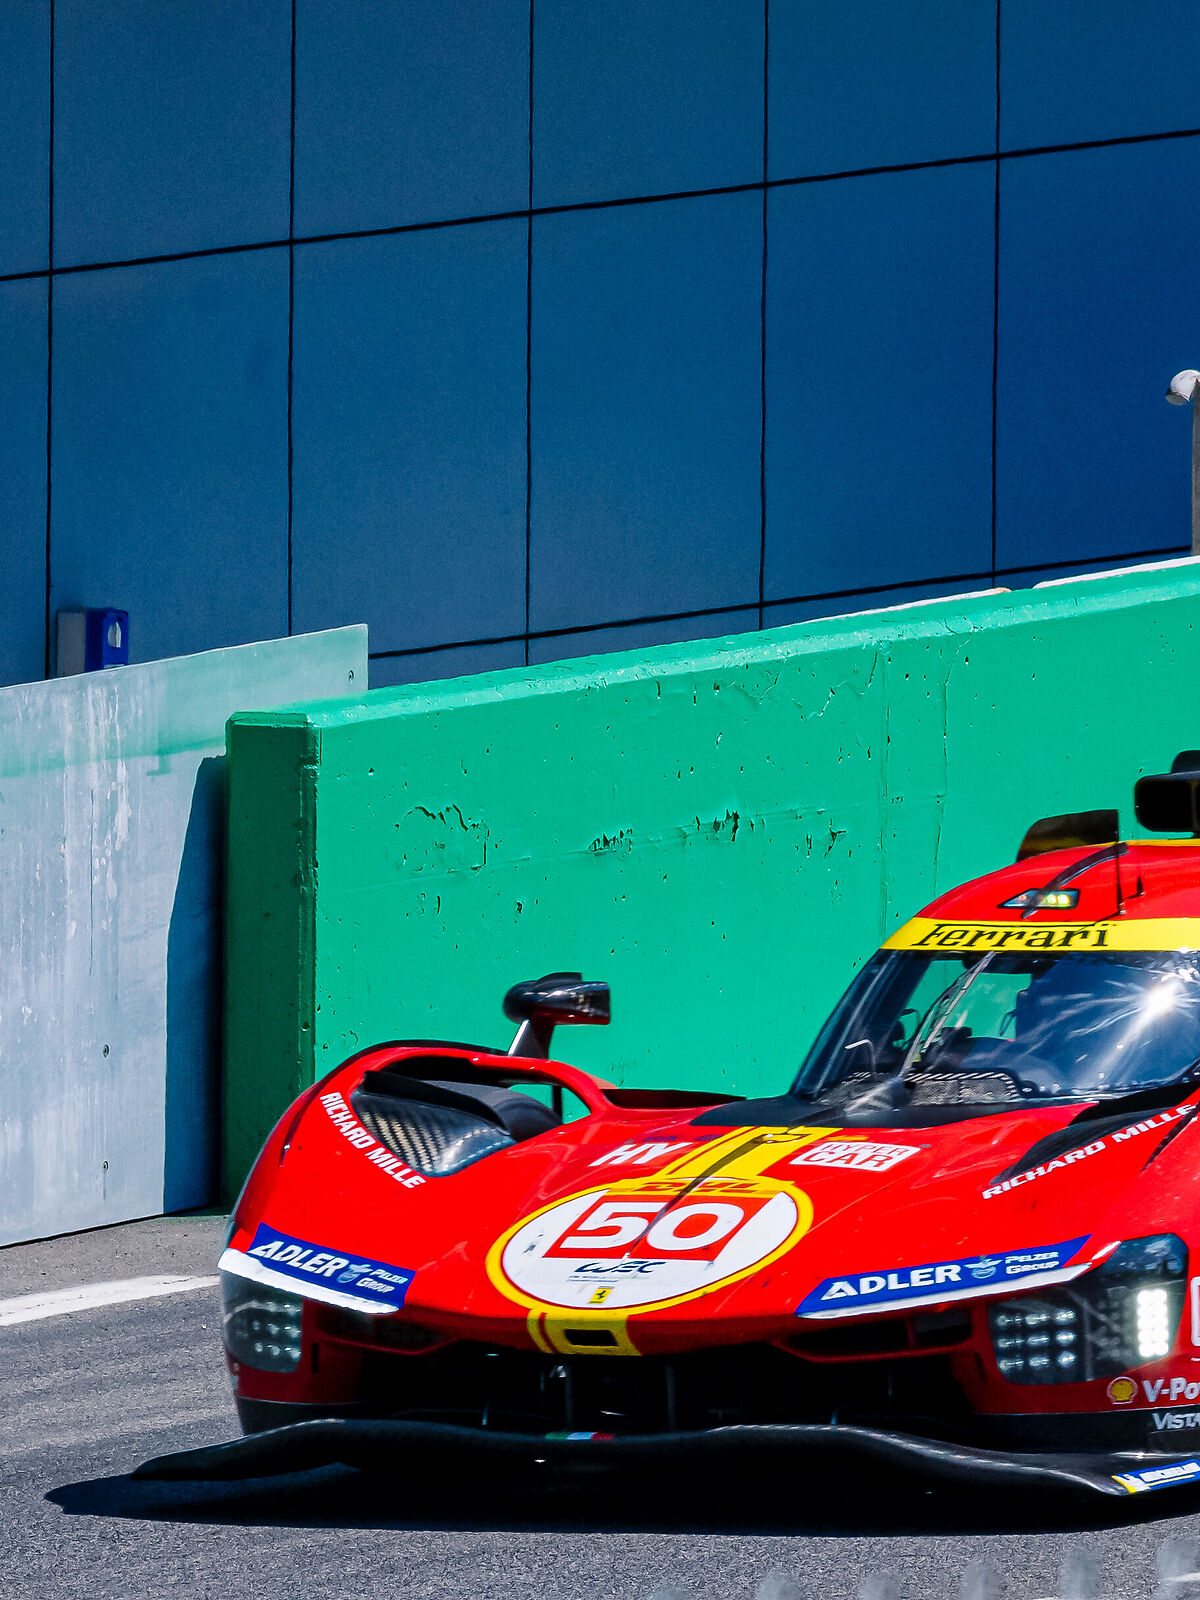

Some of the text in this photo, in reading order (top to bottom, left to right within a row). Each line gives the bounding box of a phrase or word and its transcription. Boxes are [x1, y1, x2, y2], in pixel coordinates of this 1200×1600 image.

[910, 923, 1114, 948] Ferrari
[320, 1092, 427, 1189] RICHARD MILLE
[588, 1142, 693, 1167] HY
[820, 1143, 910, 1156] HYPER
[981, 1104, 1198, 1200] RICHARD MILLE
[802, 1151, 893, 1168] CAR
[559, 1202, 745, 1251] 50
[247, 1241, 350, 1277] ADLER
[574, 1260, 667, 1274] WEC
[821, 1264, 962, 1301] ADLER
